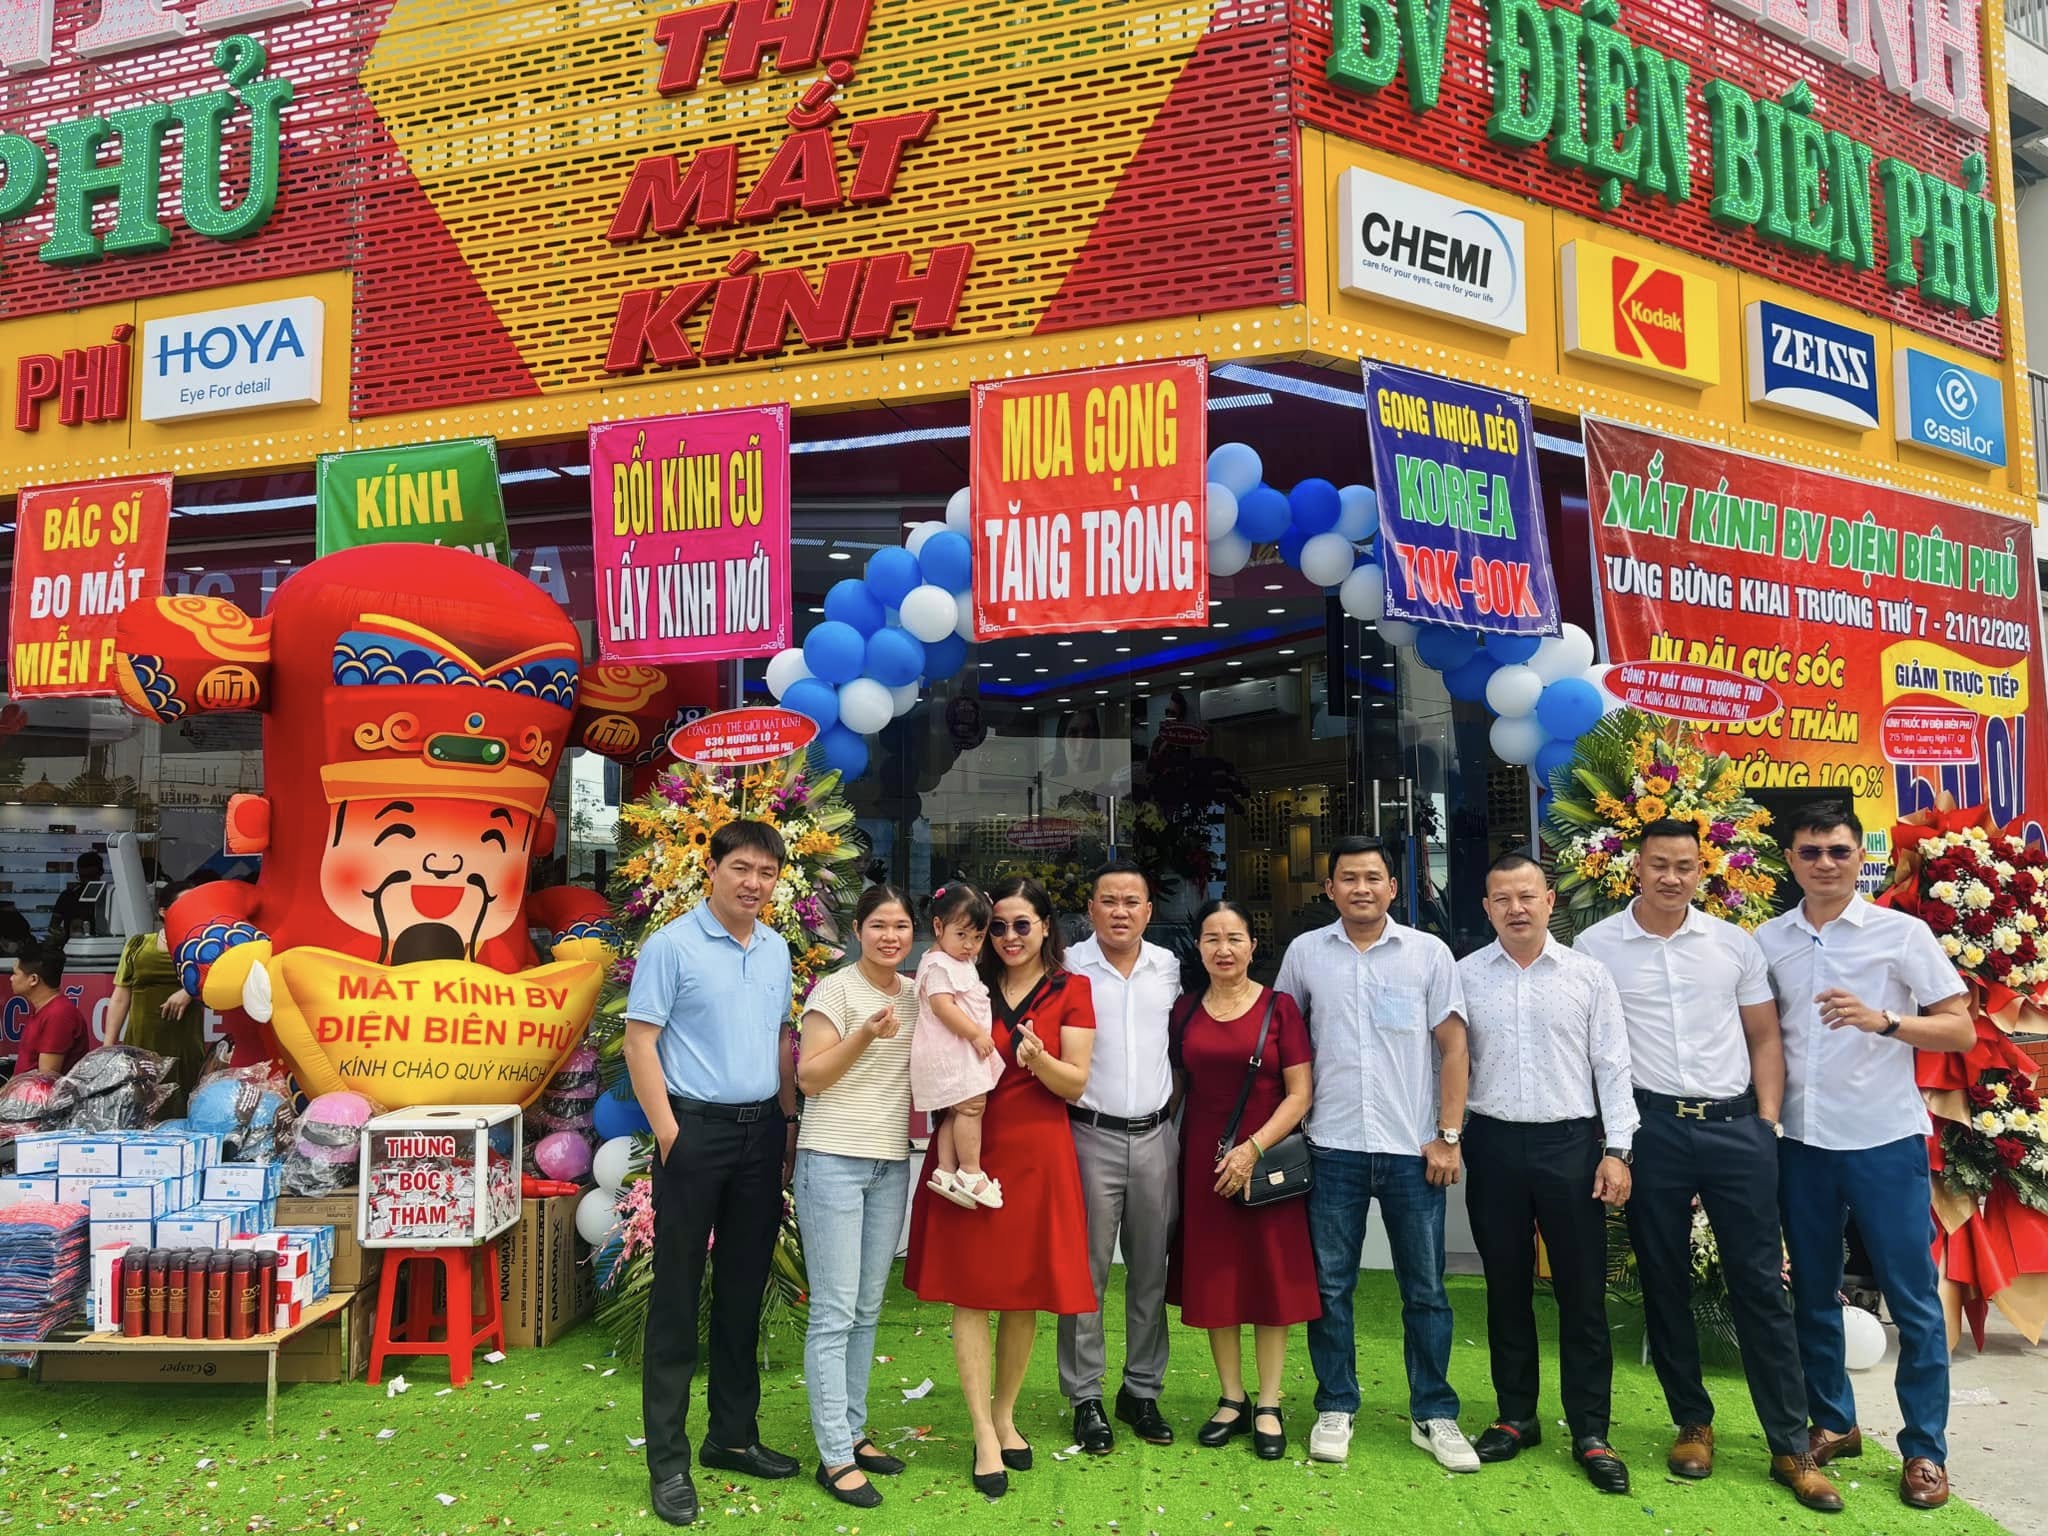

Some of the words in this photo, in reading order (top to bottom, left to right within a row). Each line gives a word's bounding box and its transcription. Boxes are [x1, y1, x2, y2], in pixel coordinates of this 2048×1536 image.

[654, 0, 875, 97] THỊ
[605, 80, 939, 247] MẮT
[1487, 0, 1690, 211] ĐIỆN
[1703, 78, 1875, 272] BIÊN
[1880, 152, 1998, 320] PHỦ
[1361, 212, 1492, 288] CHEMI
[602, 248, 975, 373] KÍNH
[1362, 258, 1379, 270] care
[1381, 262, 1392, 274] for
[1393, 268, 1411, 281] your
[1413, 273, 1433, 287] eyes,
[1434, 279, 1451, 291] care
[1452, 283, 1463, 295] for
[1464, 288, 1481, 301] your
[1483, 293, 1494, 304] life
[1631, 298, 1683, 333] Kodak
[15, 322, 134, 431] PHÍ
[152, 317, 302, 377] HOYA
[1771, 323, 1869, 390] ZEISS
[179, 385, 205, 405] Eye
[209, 383, 230, 399] For
[235, 377, 271, 396] detail
[1002, 392, 1074, 482] MUA
[1085, 379, 1177, 492] GỌNG
[1377, 388, 1430, 438] GỌNG
[1432, 401, 1482, 453] NHỰA
[1484, 404, 1518, 457] DẺO
[1923, 418, 1994, 456] essilor
[356, 463, 463, 529] KÍNH
[612, 431, 654, 536] ĐỔI
[661, 441, 721, 532] KÍNH
[728, 434, 764, 528] CŨ
[1395, 453, 1517, 540] KOREA
[43, 503, 101, 551] BÁC
[110, 490, 142, 545] SĨ
[1602, 449, 1688, 539] MẮT
[1691, 477, 1776, 558] KÍNH
[1782, 507, 1827, 564] BV
[1829, 511, 1899, 588] ĐIỆN
[1903, 523, 1963, 590] BIÊN
[1968, 532, 2019, 600] PHỦ
[985, 499, 1071, 622] TẶNG
[1082, 485, 1193, 597] TRÒNG
[1395, 542, 1541, 618] 70K-90K
[30, 575, 70, 618] ĐO
[79, 552, 145, 616] MẮT
[605, 541, 651, 642] LẤY
[657, 548, 717, 639] KÍNH
[724, 541, 770, 634] MỚI
[1602, 554, 1662, 599] TƯNG
[1670, 562, 1733, 608] BỪNG
[1740, 577, 1789, 618] KHAI
[1795, 587, 1873, 630] TRƯƠNG
[1878, 593, 1912, 636] THỨ
[1915, 606, 1927, 636] 7
[1945, 613, 2032, 652] 21/12/2024
[15, 625, 91, 687] MIỄN
[1620, 666, 1645, 684] CÔNG
[1648, 671, 1659, 687] TY
[1680, 674, 1703, 694] KÍNH
[1744, 685, 1763, 702] THU
[1688, 636, 1737, 671] ĐÃI
[1794, 642, 1846, 688] SỐC
[1895, 659, 1939, 690] GIẢM
[1942, 668, 1984, 697] TRỰC
[1988, 671, 2020, 699] TIẾP
[687, 723, 710, 737] CÔNG
[712, 723, 722, 735] TY
[781, 715, 801, 728] KÍNH
[1625, 686, 1643, 704] CHÚC
[1665, 693, 1681, 709] KHAI
[1732, 702, 1751, 719] PHÁT
[1789, 699, 1859, 744] THĂM
[760, 731, 771, 743] LỘ
[773, 732, 780, 741] 2
[1818, 767, 1885, 800] 100%
[434, 976, 513, 1007] KÍNH
[526, 988, 569, 1010] BV
[316, 1011, 410, 1049] ĐIỆN
[424, 1012, 506, 1046] BIÊN
[517, 1019, 574, 1051] PHỦ
[339, 1057, 386, 1078] KÍNH
[454, 1060, 496, 1081] QUÝ
[497, 1064, 549, 1083] KHÁCH
[385, 1131, 456, 1158] THÙNG
[399, 1163, 441, 1192] BỐC
[388, 1202, 448, 1226] THĂM
[501, 1236, 510, 1301] NANOMAX
[551, 1221, 559, 1322] NANOMAX
[159, 1362, 203, 1376] Casper
